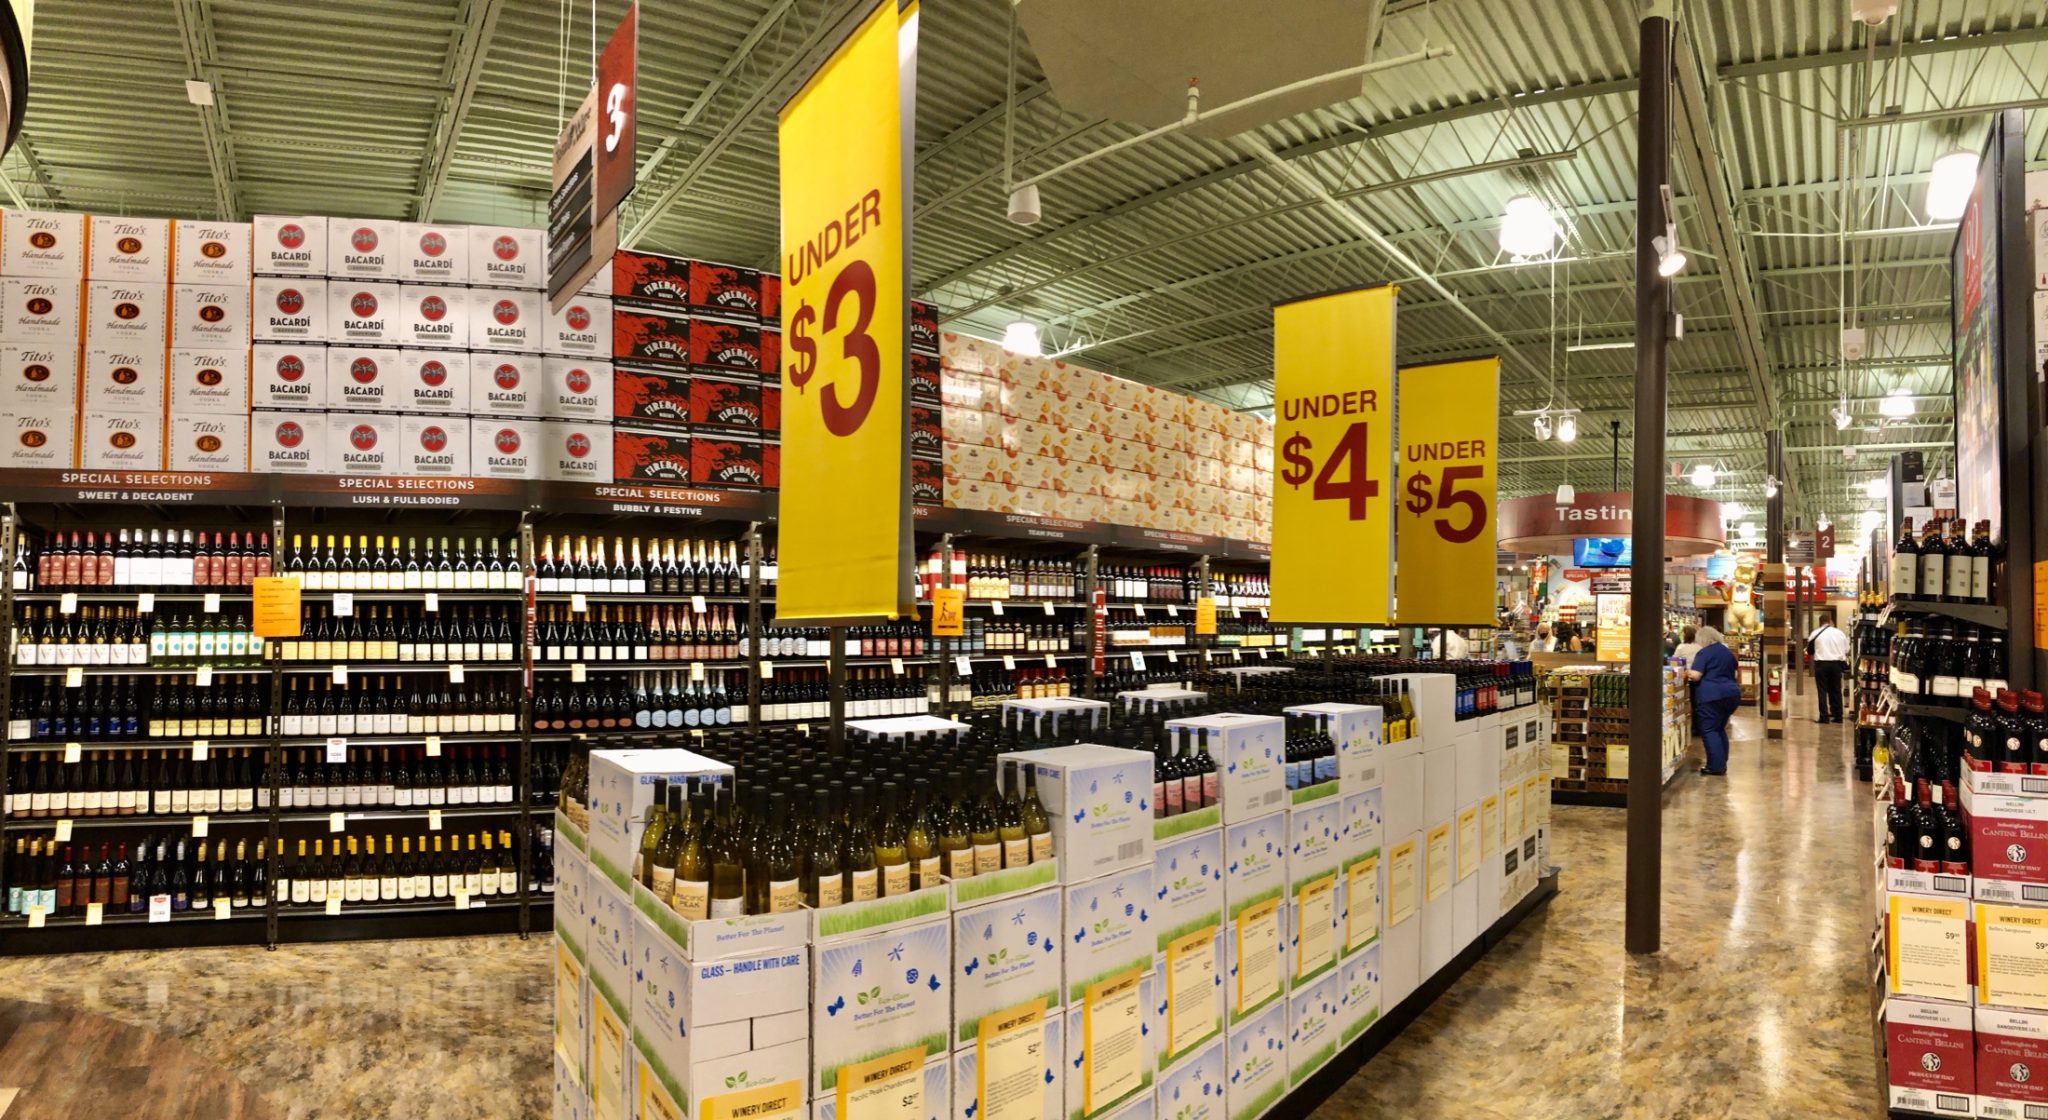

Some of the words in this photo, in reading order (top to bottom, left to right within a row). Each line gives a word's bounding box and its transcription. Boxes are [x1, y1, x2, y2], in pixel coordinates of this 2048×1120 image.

[606, 83, 625, 152] 3
[27, 218, 61, 230] Tito's
[114, 224, 146, 235] Tito's
[198, 228, 230, 241] Tito's
[789, 188, 881, 287] UNDER
[23, 284, 57, 296] Tito's
[111, 289, 144, 301] Tito's
[643, 280, 688, 300] FIREBALL
[196, 292, 229, 304] Tito's
[717, 290, 758, 310] FIREBALL
[20, 351, 55, 363] Tito's
[644, 341, 688, 361] FIREBALL
[717, 348, 759, 367] FIREBALL
[109, 354, 142, 366] Tito's
[194, 356, 226, 368] Tito's
[788, 298, 881, 437] $3
[644, 400, 689, 421] FIREBALL
[1283, 389, 1377, 421] UNDER
[17, 417, 51, 429] Tito's
[718, 406, 759, 426] FIREBALL
[107, 418, 140, 431] Tito's
[192, 422, 225, 433] Tito's
[1407, 439, 1486, 462] UNDER
[644, 460, 689, 481] FIREBALL
[720, 465, 760, 484] FIREBALL
[1281, 422, 1379, 521] $4
[61, 472, 120, 484] SPECIAL
[126, 474, 211, 485] SELECTIONS
[339, 478, 393, 489] SPECIAL
[397, 479, 475, 490] SELECTIONS
[78, 491, 119, 501] SWEET
[121, 491, 129, 501] &
[132, 491, 194, 502] DECADENT
[352, 495, 381, 504] LUSH
[383, 495, 391, 505] &
[595, 487, 644, 498] SPECIAL
[649, 490, 721, 502] SELECTIONS
[613, 504, 651, 513] BUBBLY
[653, 504, 661, 513] &
[663, 506, 703, 515] FESTIVE
[1406, 465, 1487, 544] $5
[1555, 505, 1633, 521] Tastin
[1006, 515, 1038, 525] SPECIAL
[1040, 518, 1084, 529] SELECTIONS
[1822, 536, 1830, 548] 2
[1911, 906, 1933, 915] WINERY
[1933, 907, 1952, 916] DIRECT
[1999, 916, 2021, 924] WINERY
[2022, 917, 2041, 925] DIRECT
[701, 965, 724, 979] GLASS
[733, 959, 762, 974] HANDLE
[762, 957, 780, 970] WITH
[781, 954, 800, 967] CARE
[864, 1069, 889, 1084] WINERY
[889, 1060, 914, 1076] DIRECT
[731, 1103, 762, 1119] WINERY
[761, 1097, 788, 1113] DIRECT
